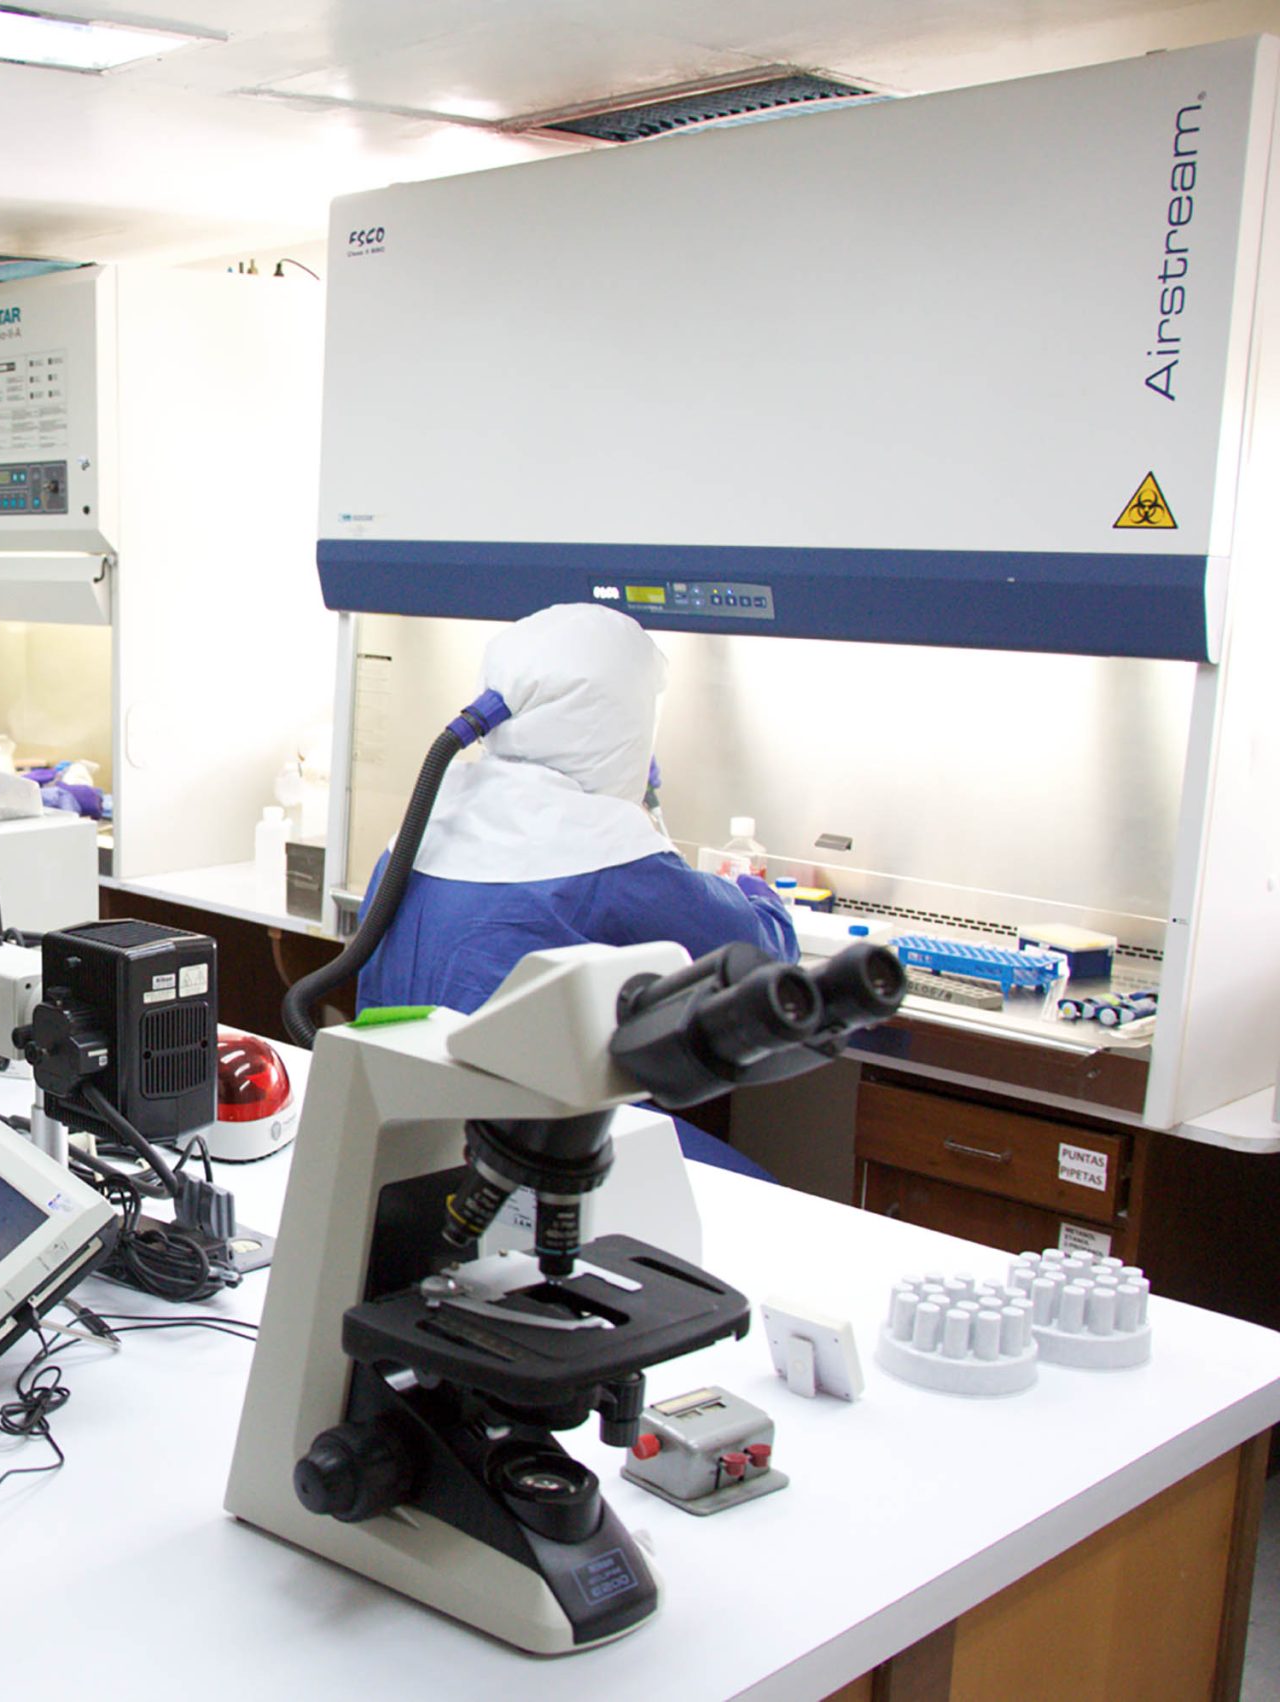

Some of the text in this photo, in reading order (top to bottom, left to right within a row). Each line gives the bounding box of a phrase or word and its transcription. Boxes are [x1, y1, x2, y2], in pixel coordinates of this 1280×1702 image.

[1144, 103, 1203, 402] Airstream
[1062, 1147, 1105, 1168] PUNTAS
[1060, 1165, 1103, 1186] PIPETAS
